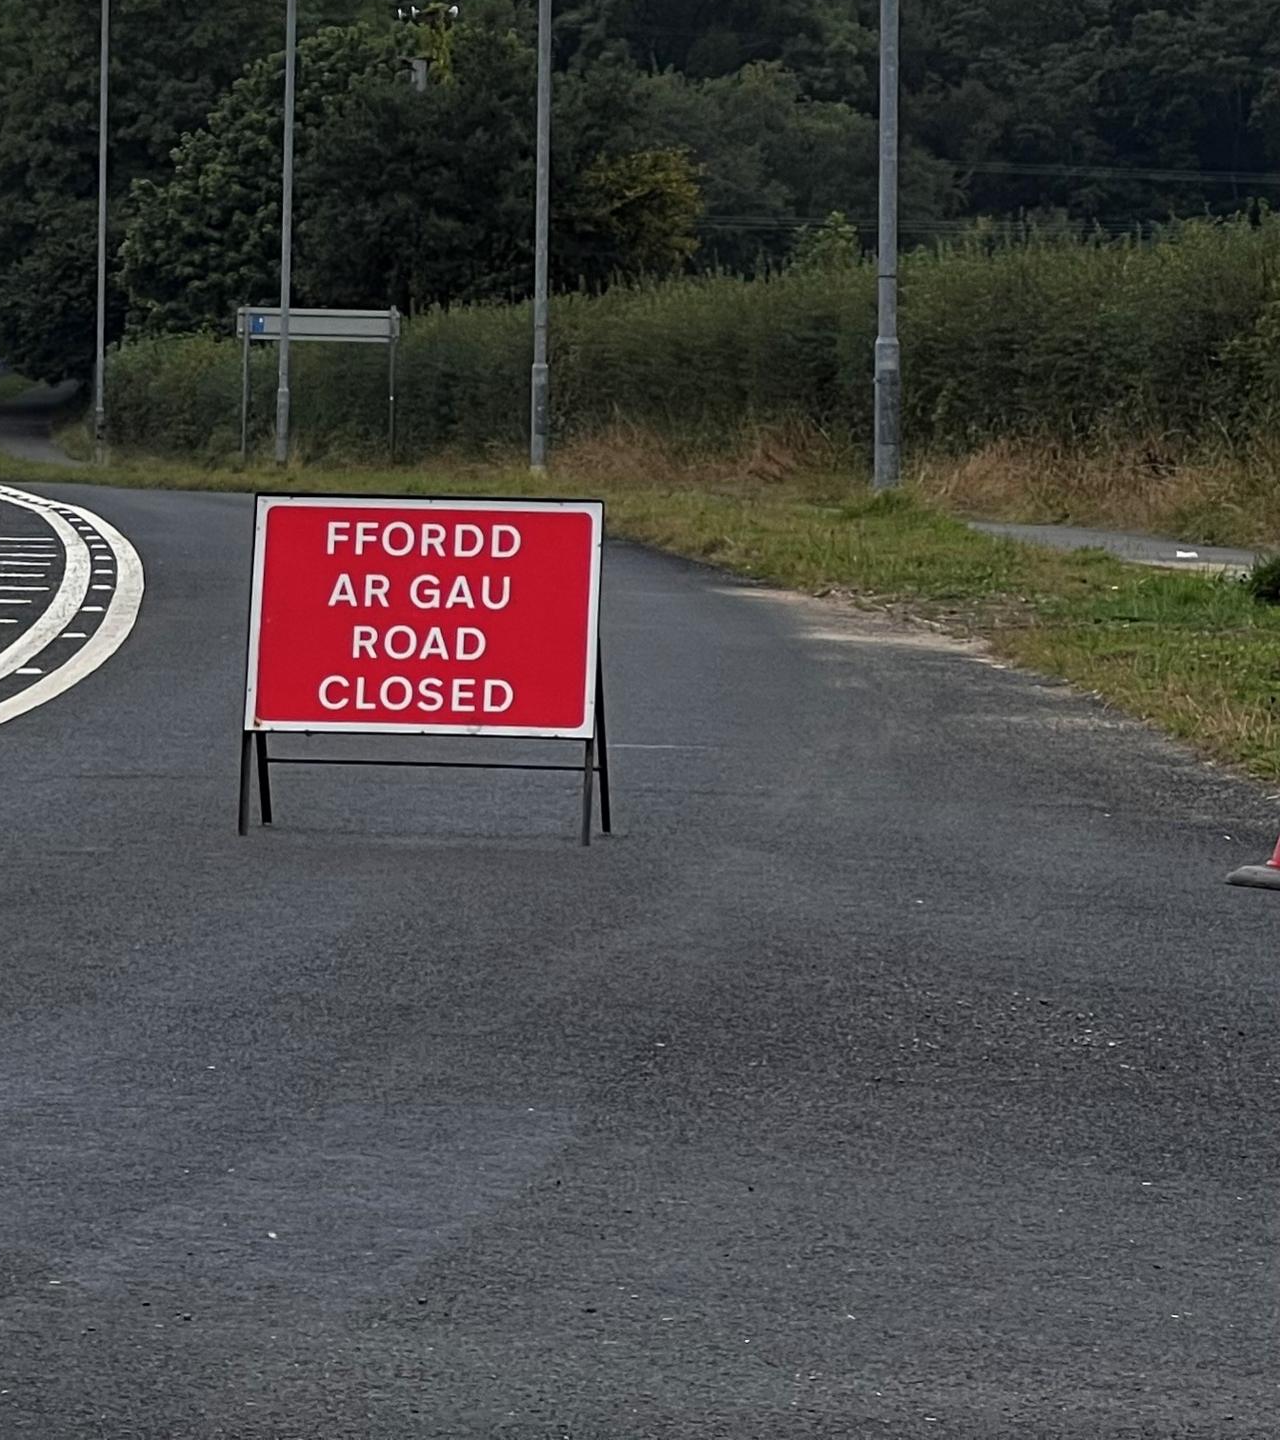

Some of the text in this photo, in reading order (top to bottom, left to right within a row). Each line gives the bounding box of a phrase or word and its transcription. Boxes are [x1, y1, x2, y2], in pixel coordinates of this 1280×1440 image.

[326, 521, 521, 558] FFORDD
[328, 574, 511, 609] AR GAU
[352, 626, 486, 660] ROAD
[318, 675, 514, 713] CLOSED
